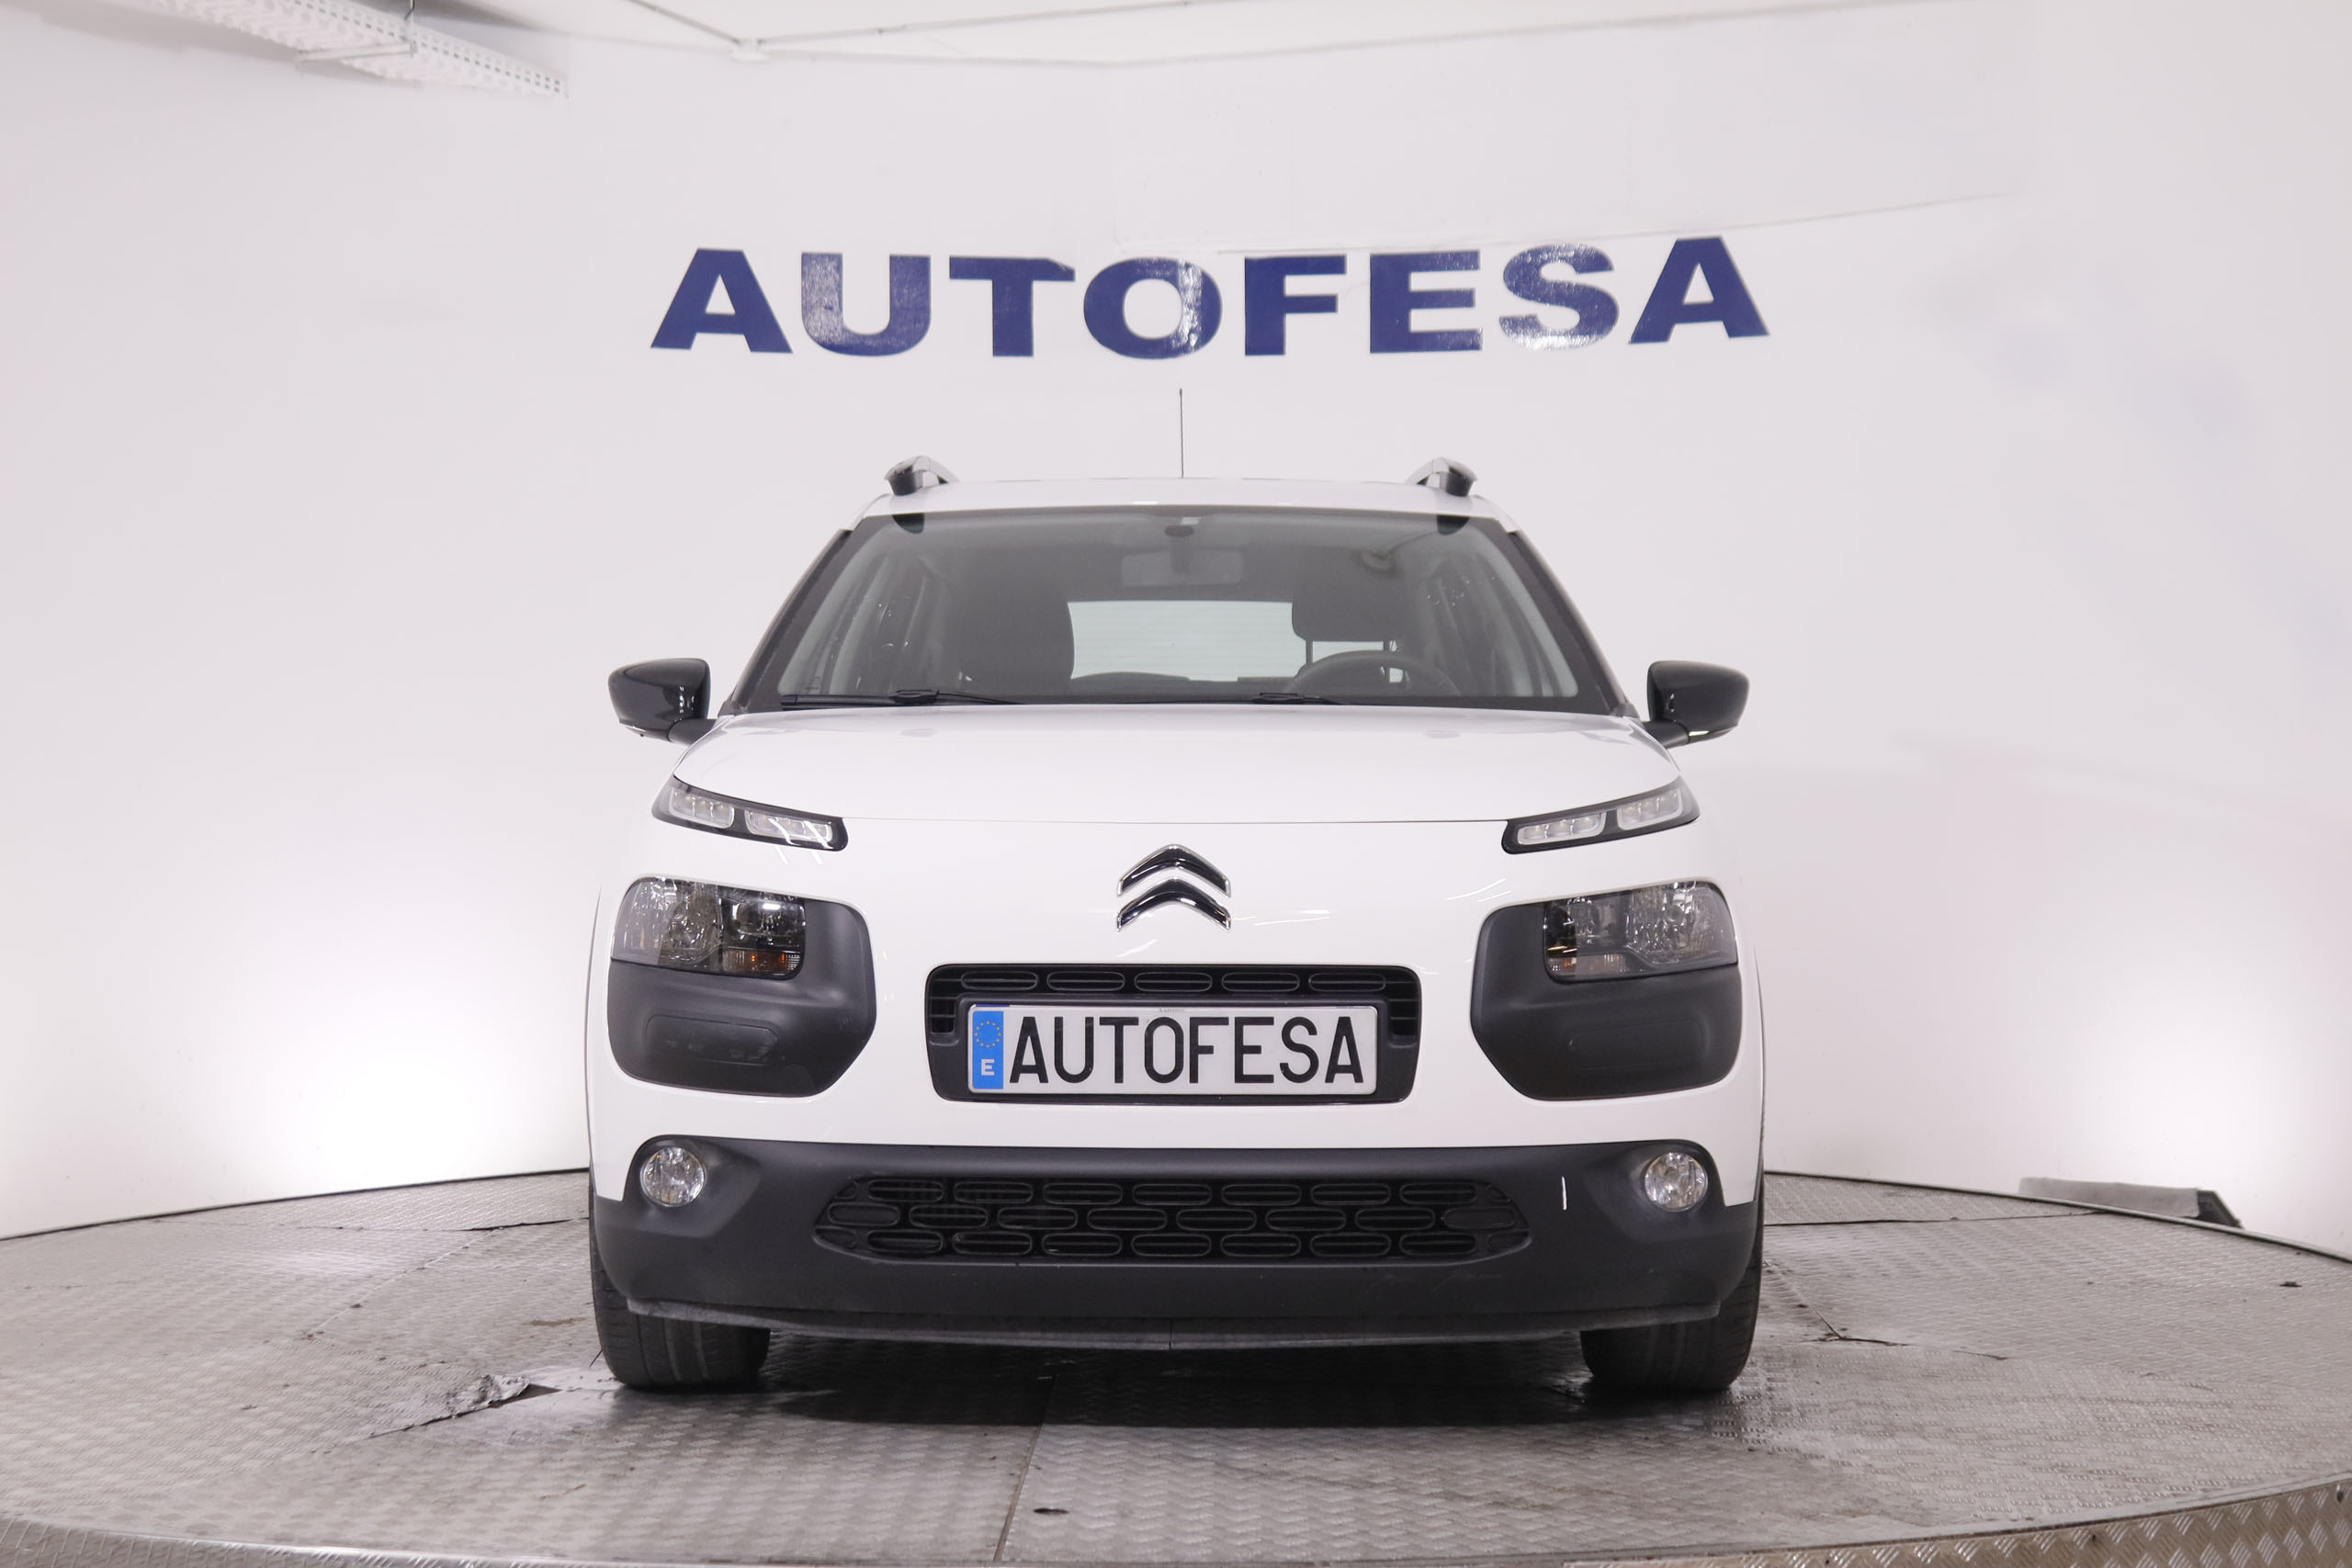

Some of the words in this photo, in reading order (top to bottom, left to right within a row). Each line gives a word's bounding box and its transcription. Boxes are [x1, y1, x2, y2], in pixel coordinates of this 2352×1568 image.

[650, 237, 1770, 359] AUTOFESA
[980, 1058, 995, 1076] E
[1010, 1016, 1364, 1084] AUTOFESA
